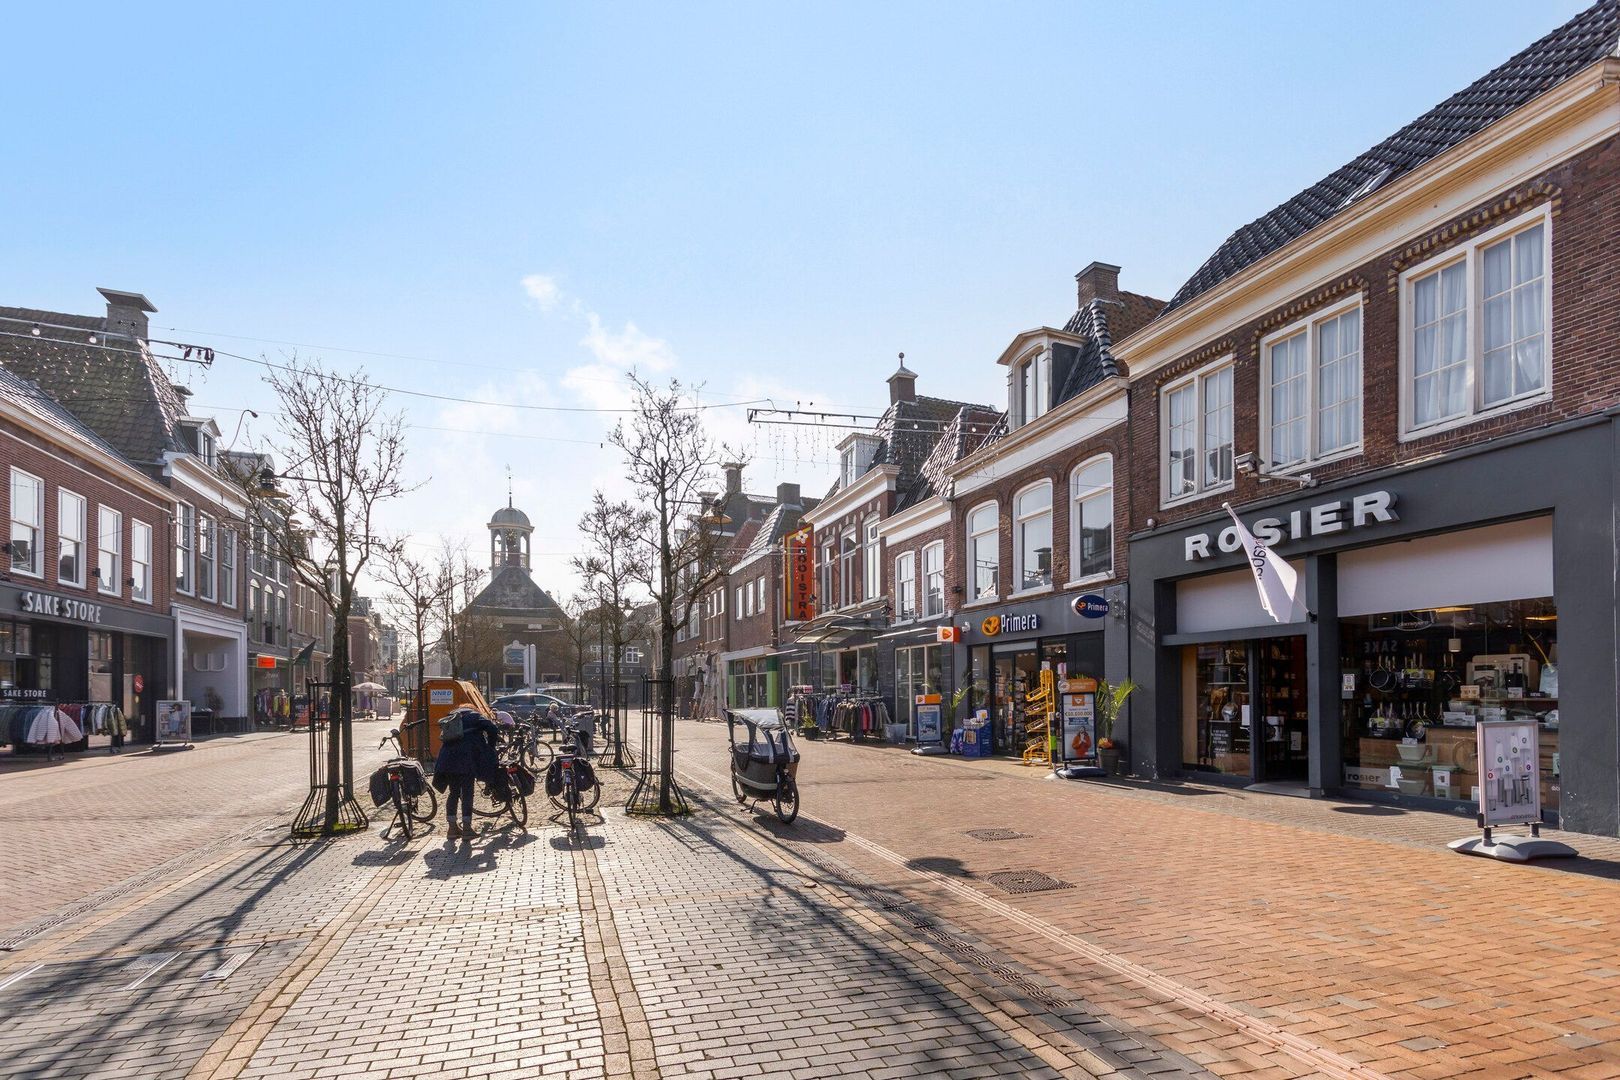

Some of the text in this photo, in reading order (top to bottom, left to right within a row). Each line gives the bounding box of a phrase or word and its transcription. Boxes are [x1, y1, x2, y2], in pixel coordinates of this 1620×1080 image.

[1184, 490, 1394, 562] ROSIER
[26, 591, 101, 623] SAKE STORE
[1088, 602, 1109, 612] Primera
[1001, 613, 1037, 633] Primera
[3, 689, 47, 698] SAKE STORE
[1347, 773, 1381, 782] rosier
